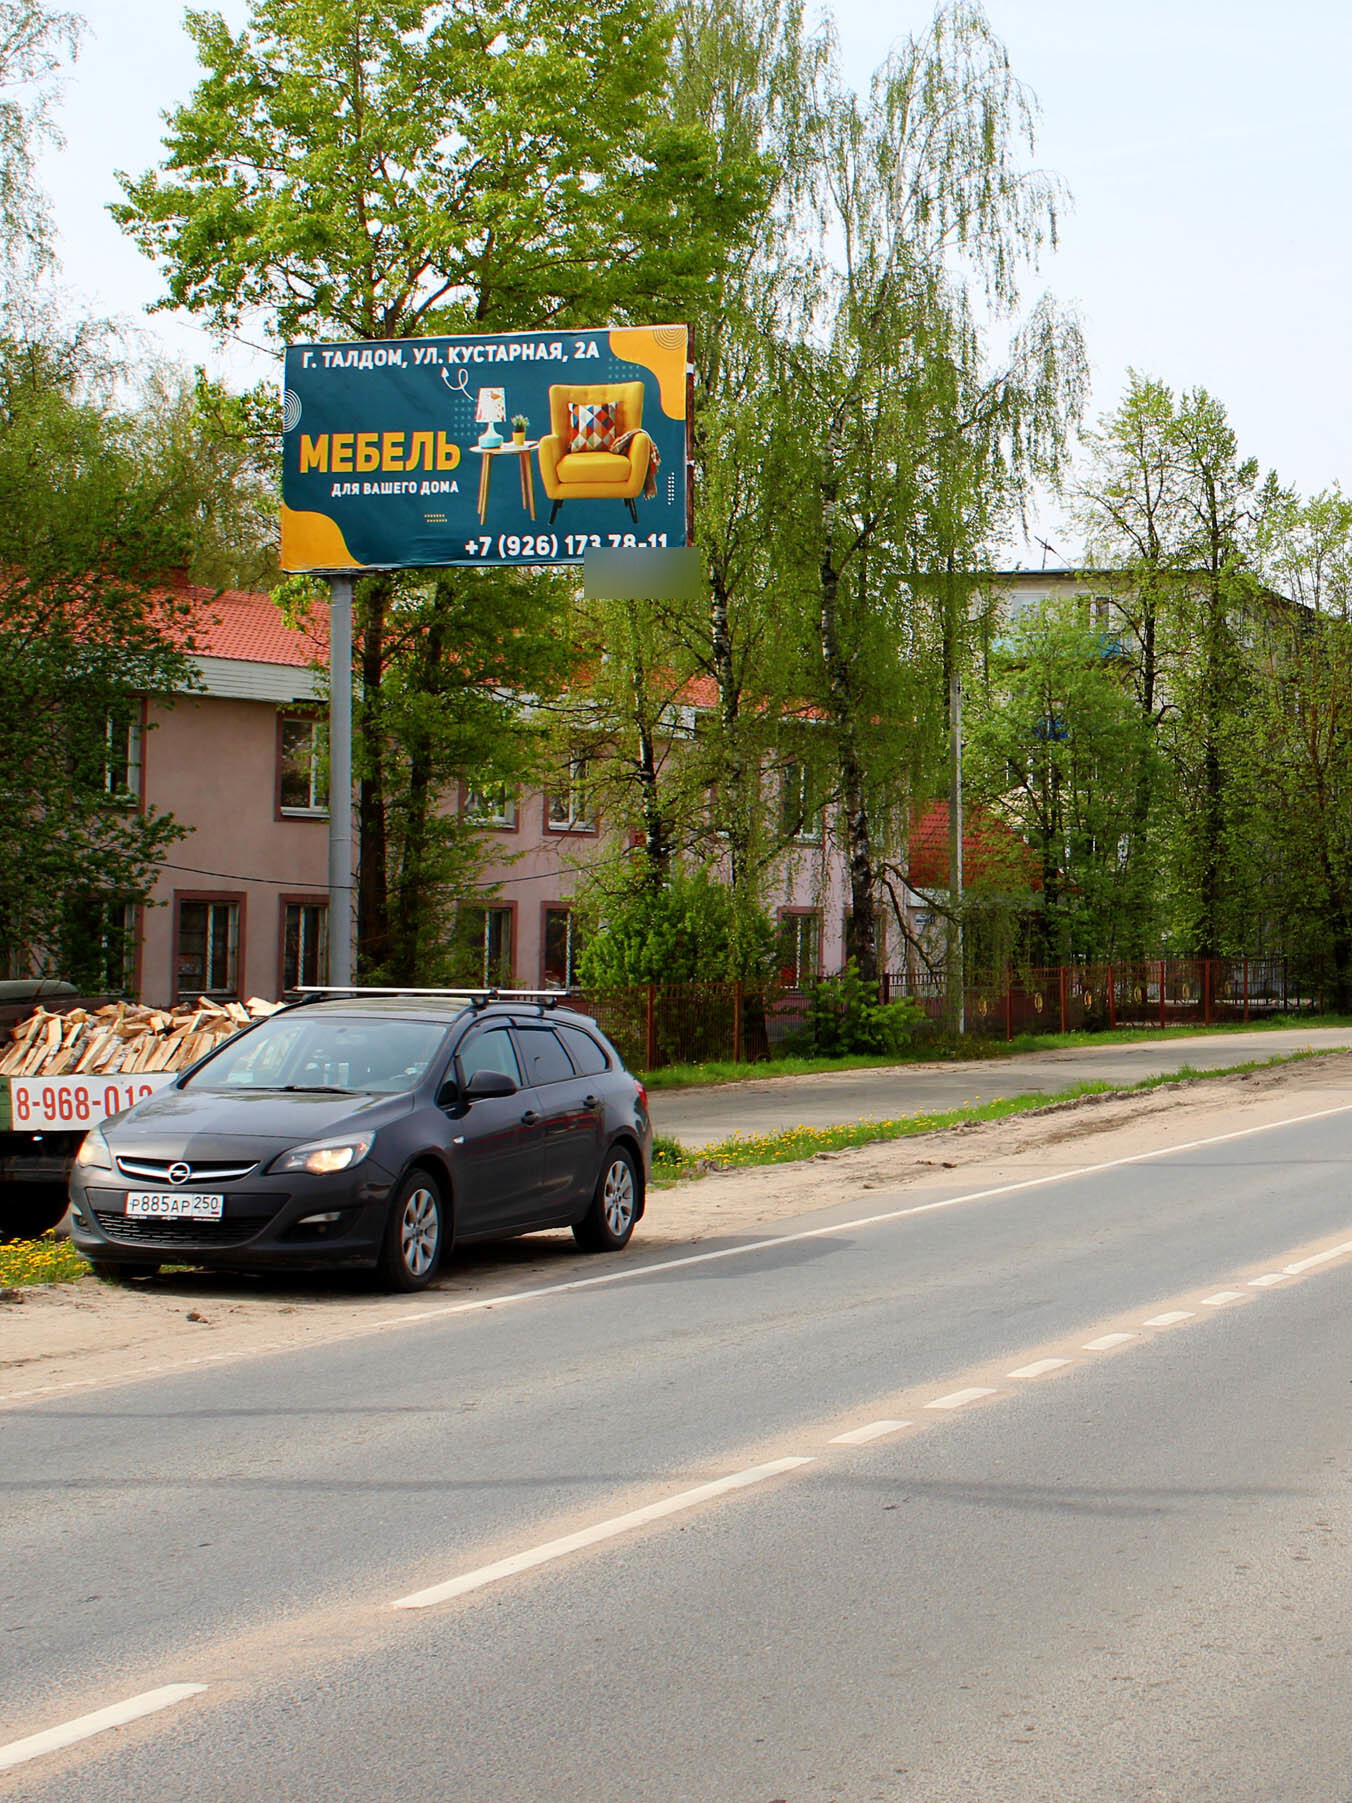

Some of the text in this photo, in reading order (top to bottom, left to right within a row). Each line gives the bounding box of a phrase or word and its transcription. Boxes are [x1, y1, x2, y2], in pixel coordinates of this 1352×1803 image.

[302, 341, 600, 370] Г. ТАЛДОМ, УЛ. КУСТАРНАЯ, 2А
[299, 430, 461, 473] МЕБЕЛЬ
[331, 480, 460, 498] ДЛЯ ВАШЕГО ДОМА
[465, 535, 492, 557] +7
[498, 533, 558, 558] (926)
[193, 1196, 219, 1210] 250
